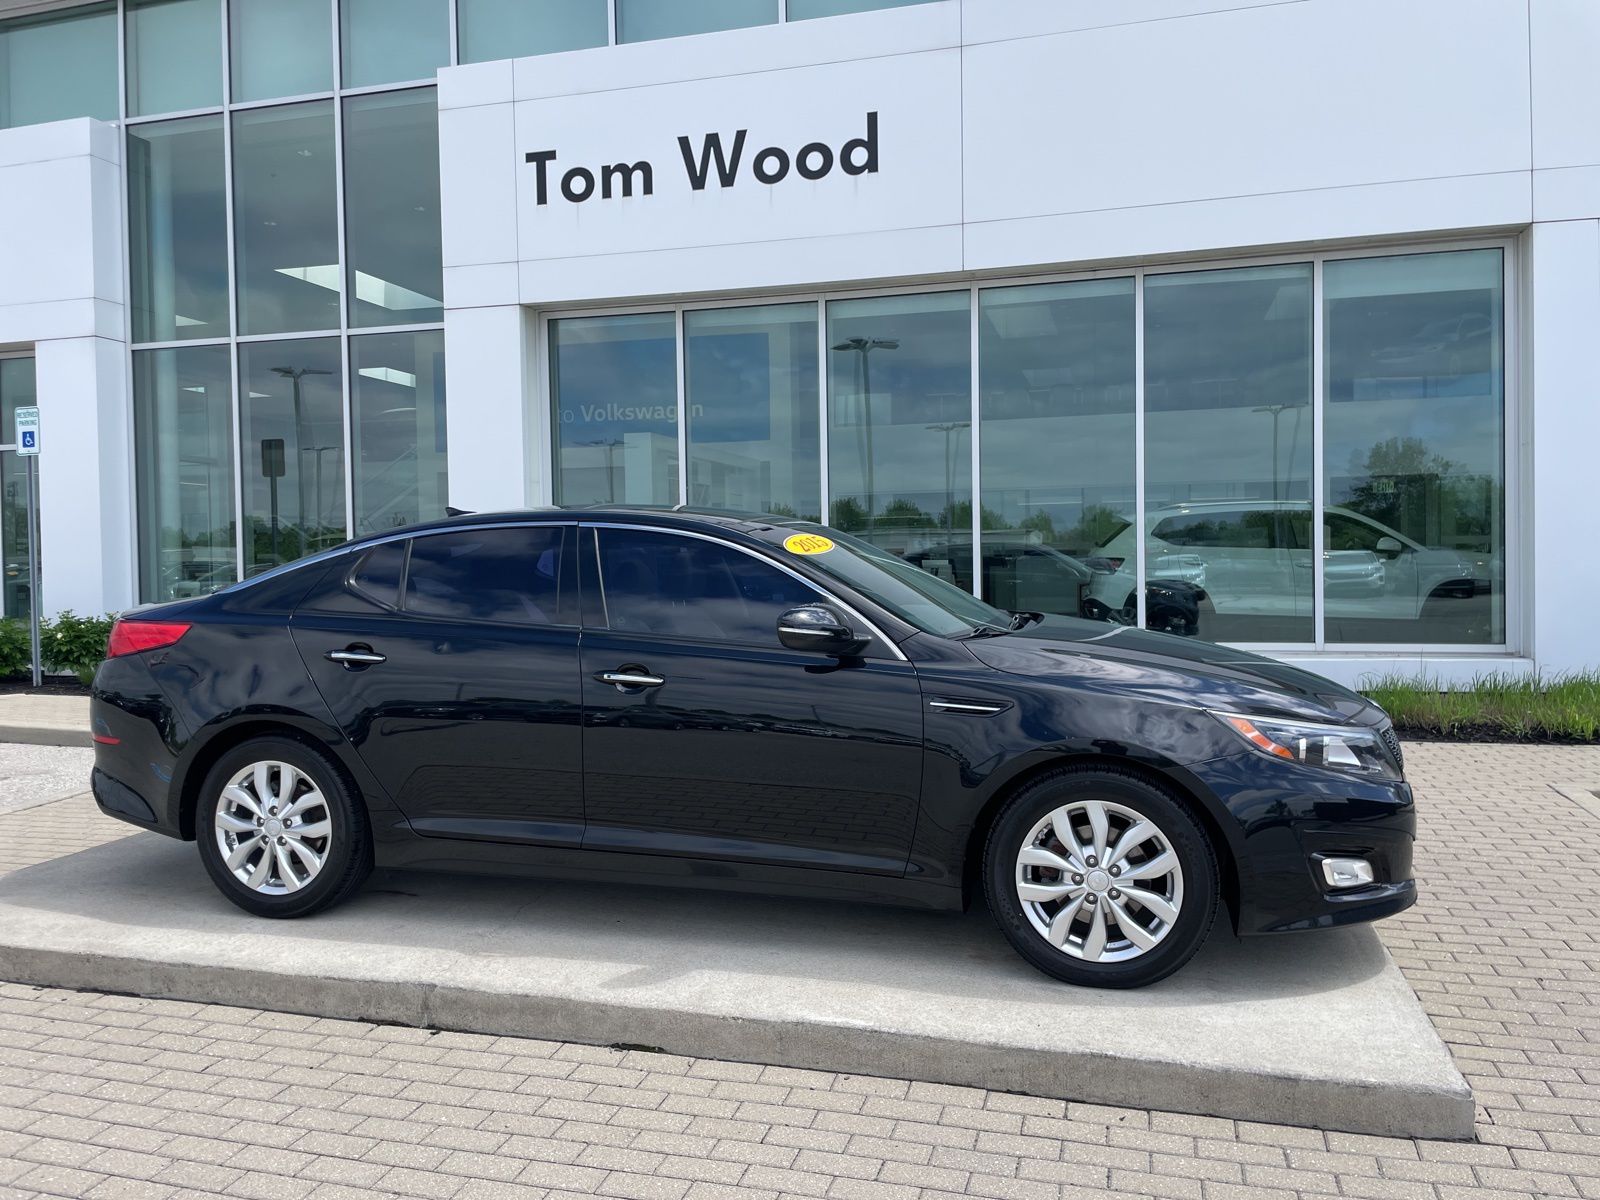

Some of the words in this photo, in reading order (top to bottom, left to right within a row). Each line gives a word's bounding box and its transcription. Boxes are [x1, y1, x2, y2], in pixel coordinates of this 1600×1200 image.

[525, 149, 653, 206] Tom
[677, 111, 879, 191] Wood
[580, 403, 704, 424] Volkswagn
[792, 535, 829, 552] 2015
